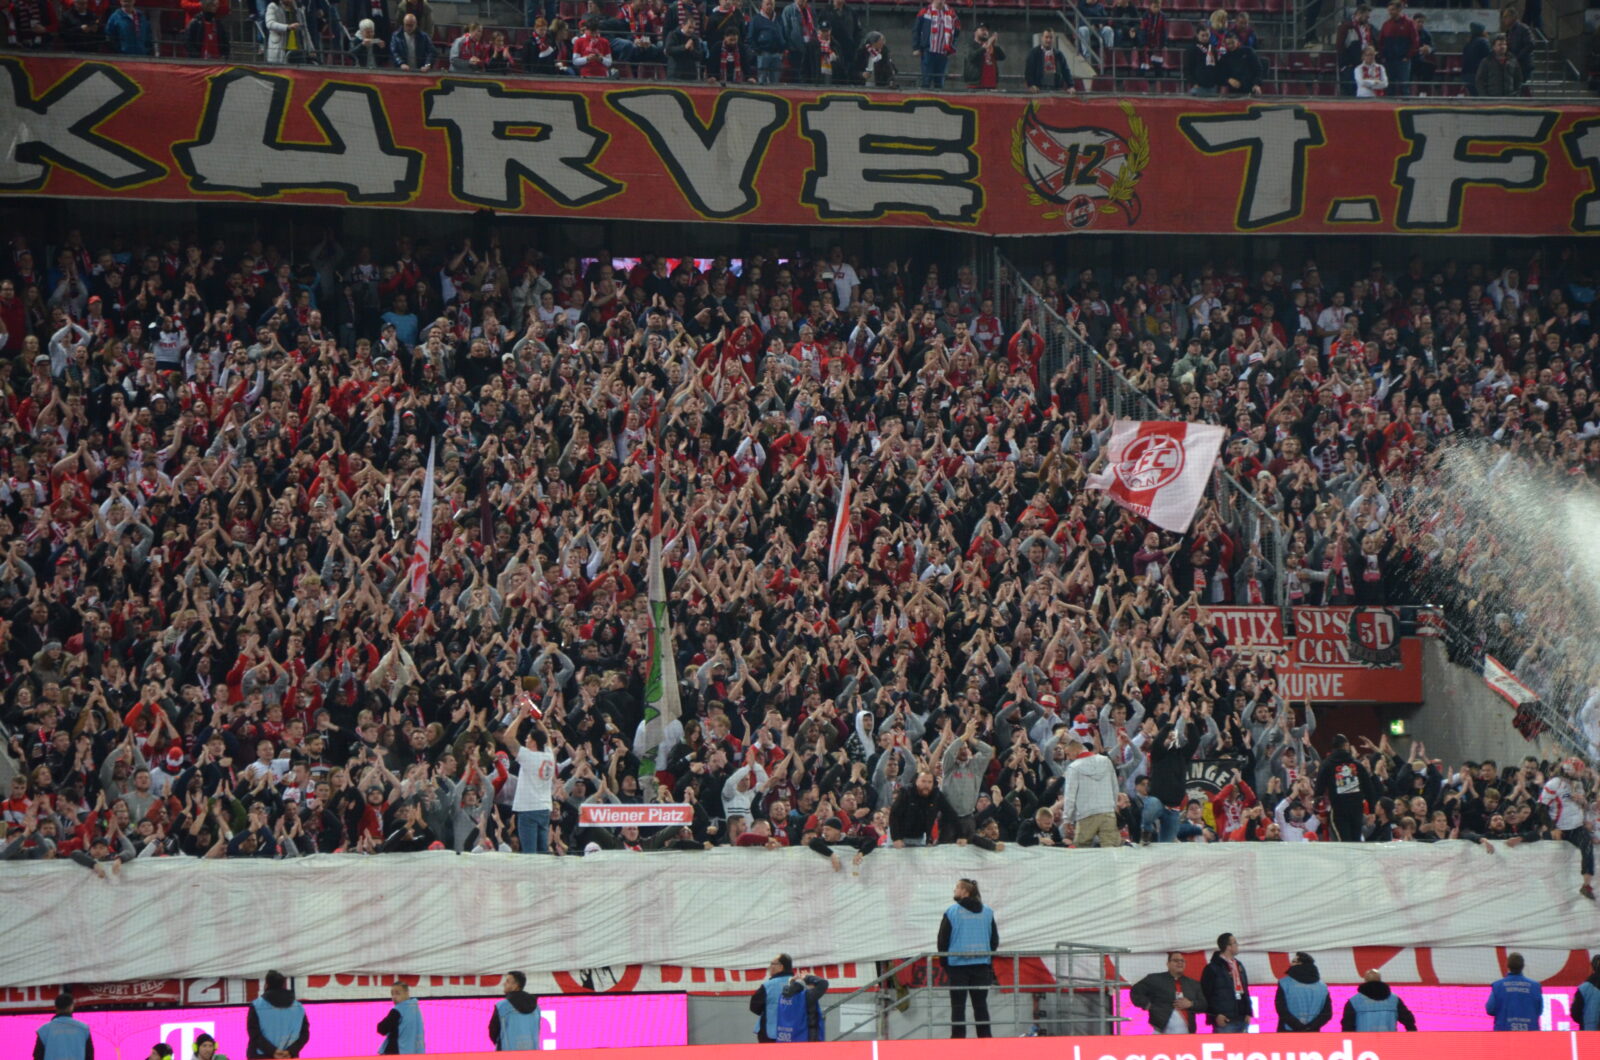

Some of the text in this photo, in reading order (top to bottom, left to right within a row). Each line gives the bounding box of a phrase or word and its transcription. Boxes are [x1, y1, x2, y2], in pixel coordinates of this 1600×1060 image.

[1063, 143, 1106, 186] 12
[1297, 610, 1348, 635] SPS
[1298, 638, 1350, 663] CGN
[1278, 673, 1345, 697] KURVE
[589, 807, 685, 822] Wiener Platz
